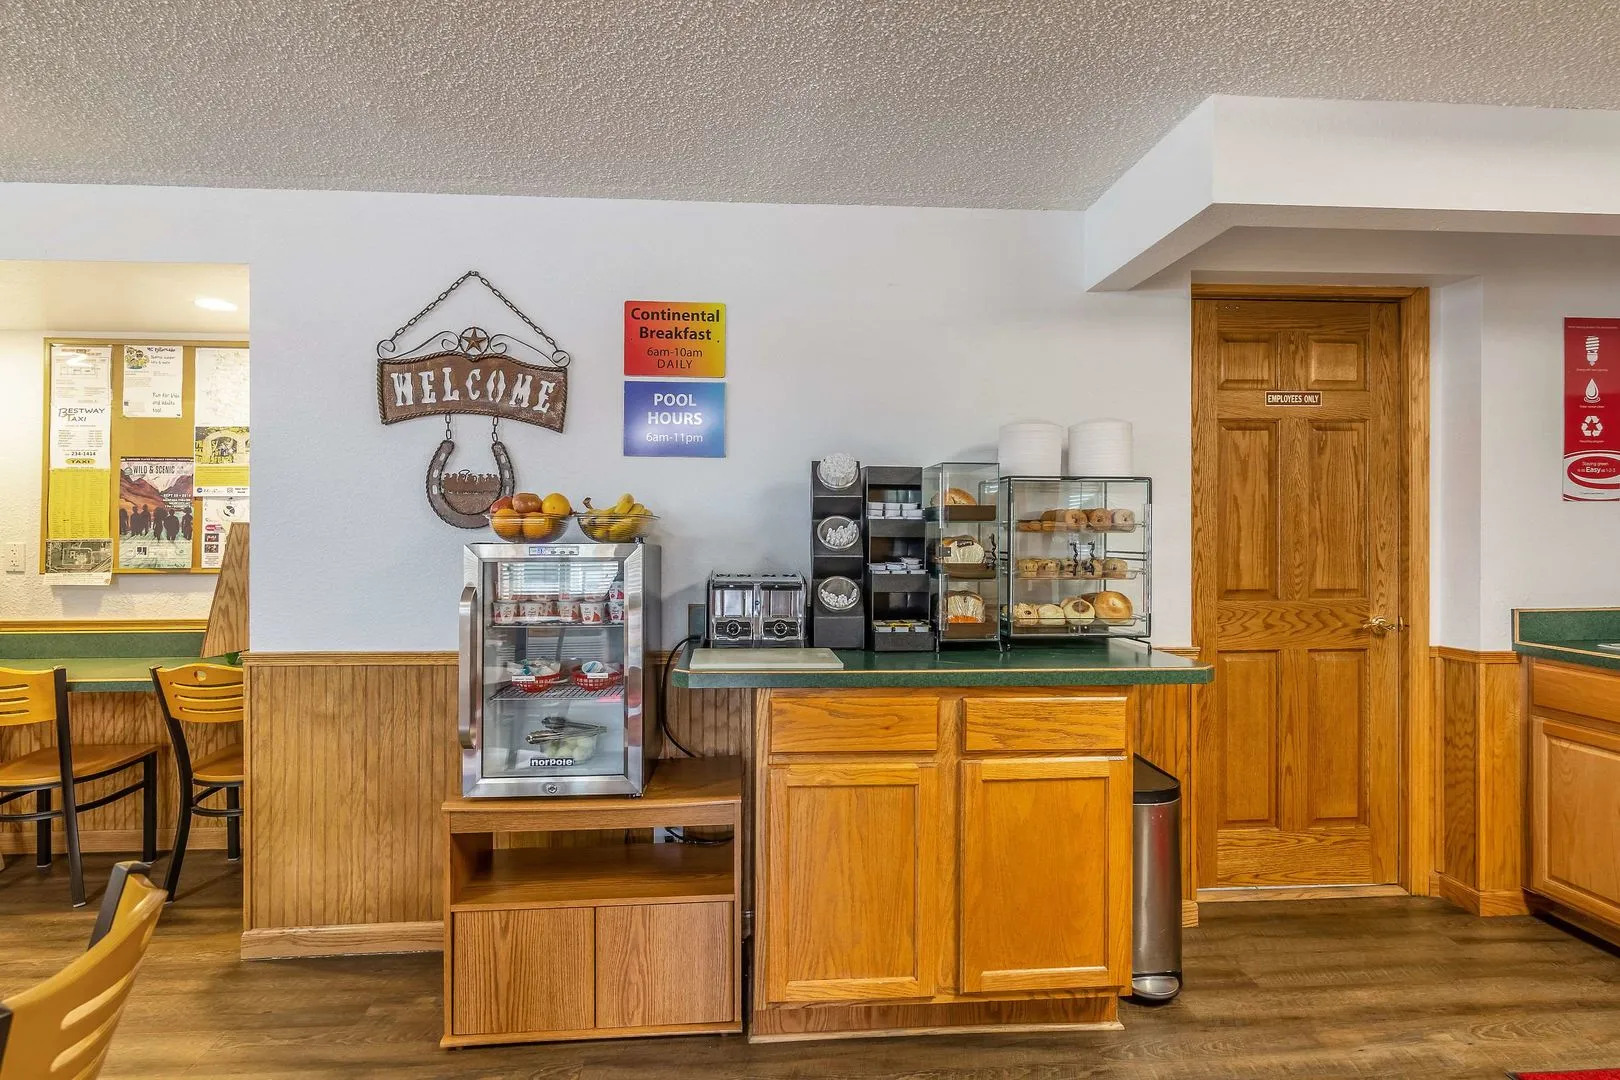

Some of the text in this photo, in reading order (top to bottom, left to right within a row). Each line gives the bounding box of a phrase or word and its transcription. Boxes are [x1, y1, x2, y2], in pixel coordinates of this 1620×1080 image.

[630, 307, 720, 322] Continental
[639, 326, 712, 340] Breakfast
[646, 347, 703, 357] 6am-10am
[657, 359, 693, 369] DAILY
[390, 366, 556, 414] WELCOME
[653, 393, 697, 406] POOL
[1267, 394, 1320, 403] EMPLOYEES ONLY
[58, 407, 106, 417] BESTWAY
[67, 413, 87, 422] TAXI
[647, 411, 703, 425] HOURS
[646, 432, 703, 445] 6am-11pm
[133, 465, 148, 474] WILD
[149, 465, 154, 474] &
[155, 465, 176, 474] SCENIC
[1585, 466, 1602, 474] Easy
[531, 758, 573, 766] norpole
